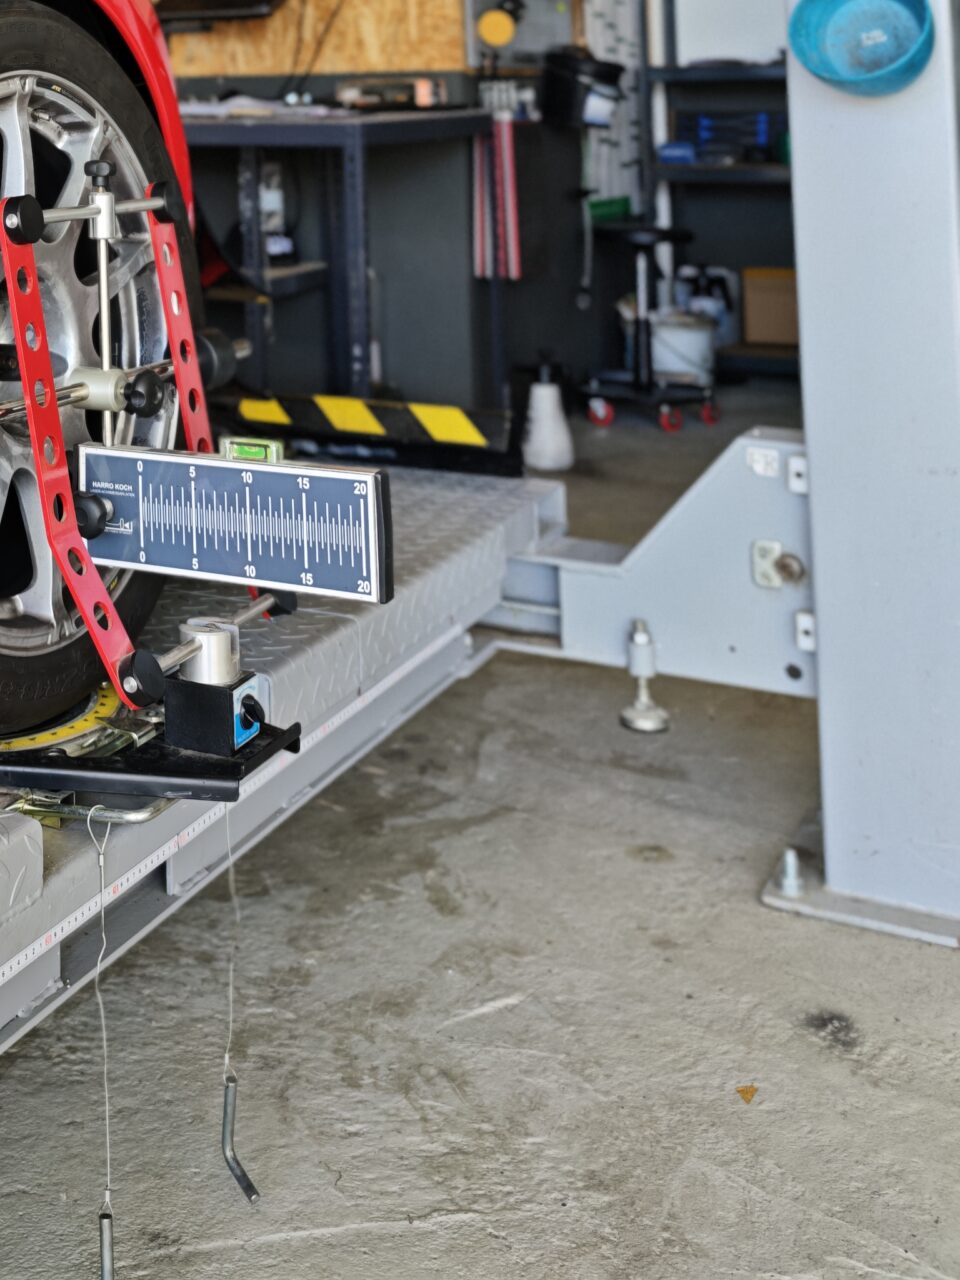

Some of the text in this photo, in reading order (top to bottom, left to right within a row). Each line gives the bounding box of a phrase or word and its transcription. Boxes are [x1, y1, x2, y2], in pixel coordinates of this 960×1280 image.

[92, 481, 133, 492] HARRO KOCH
[137, 461, 367, 496] 0 5 10 15 20
[140, 552, 370, 593] 0 5 10 15 20
